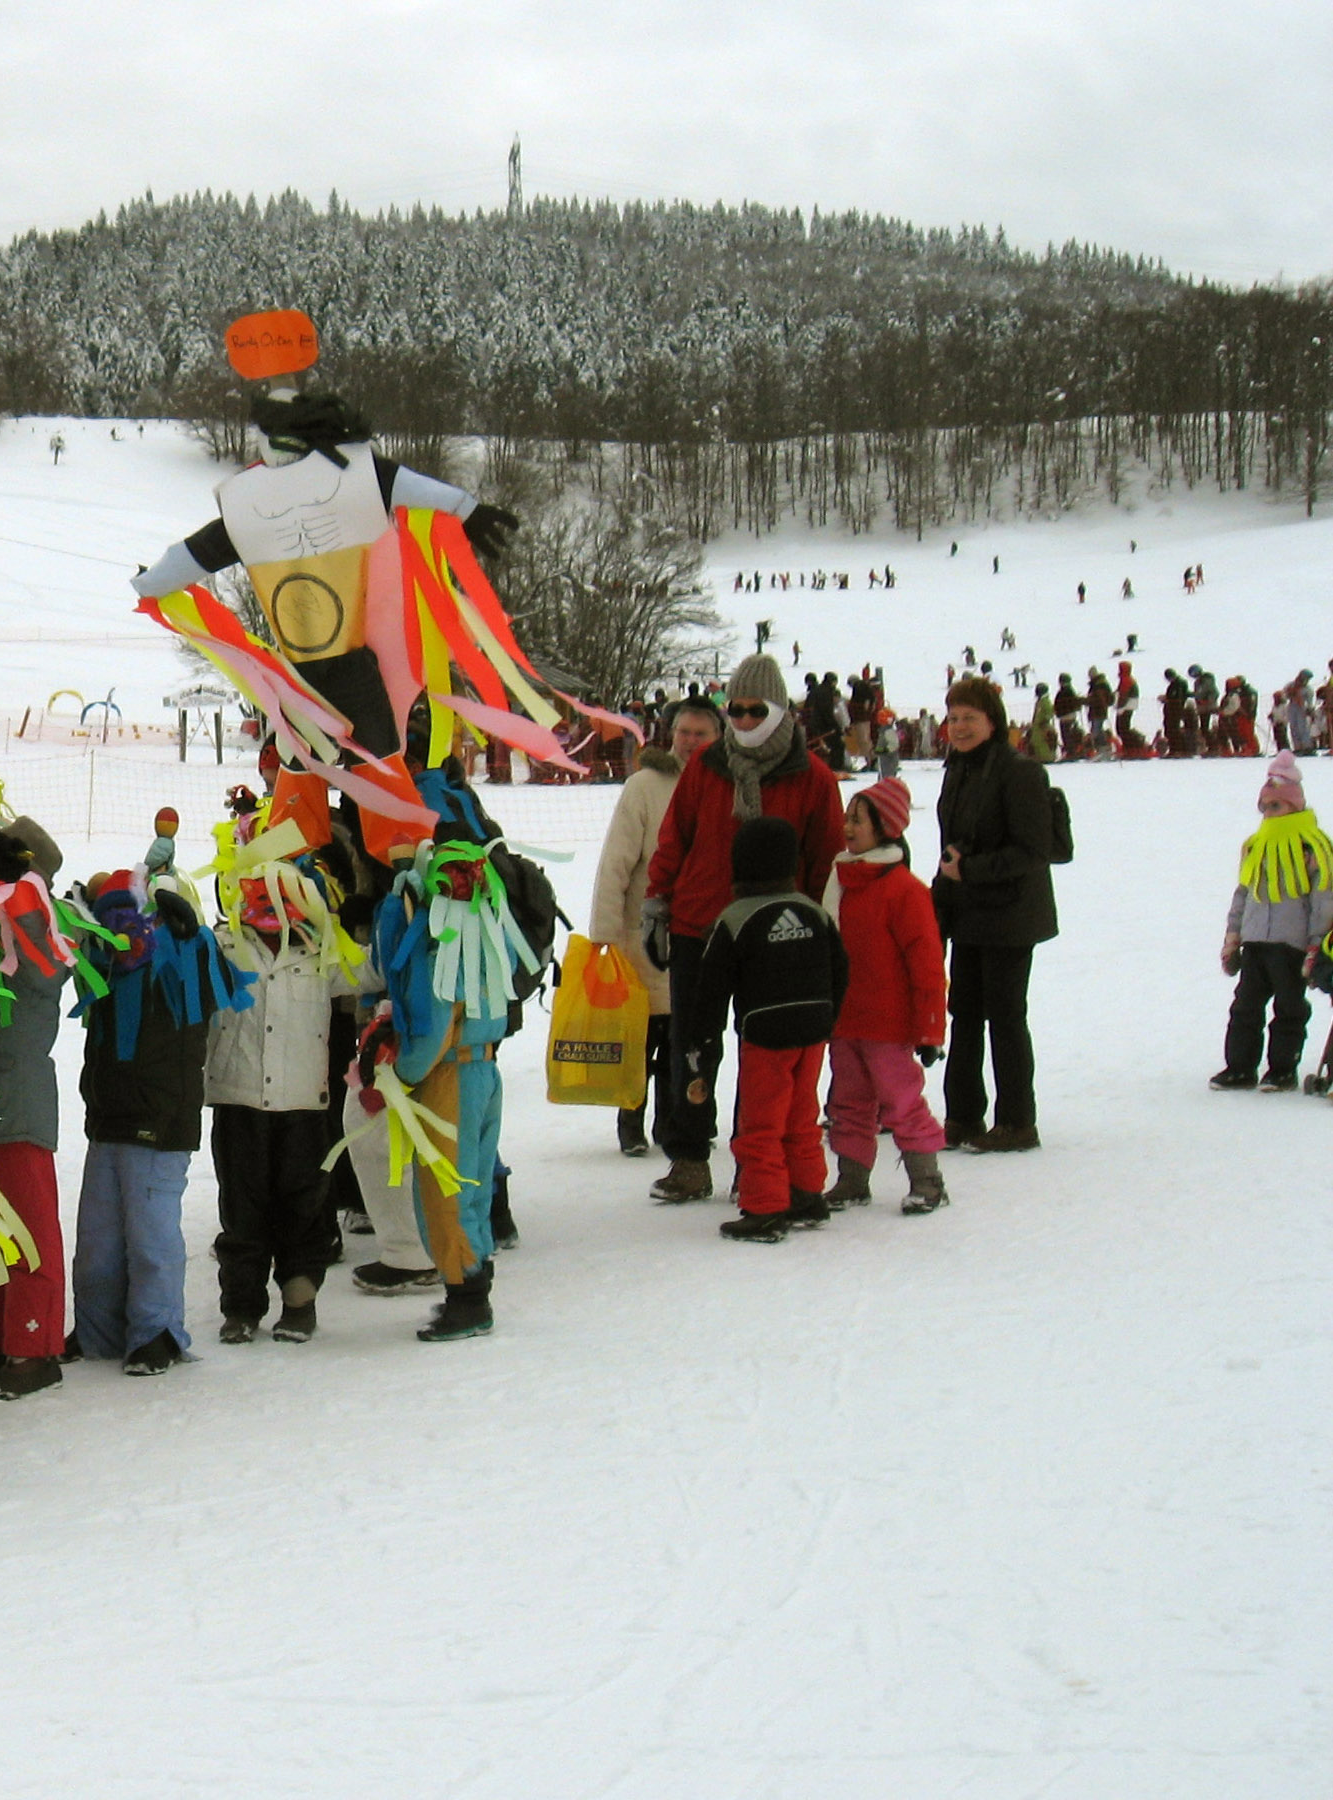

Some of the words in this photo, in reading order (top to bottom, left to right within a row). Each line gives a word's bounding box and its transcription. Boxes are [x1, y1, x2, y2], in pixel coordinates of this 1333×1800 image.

[768, 927, 813, 942] adidas
[556, 1042, 571, 1051] LA
[574, 1043, 612, 1053] HALLE
